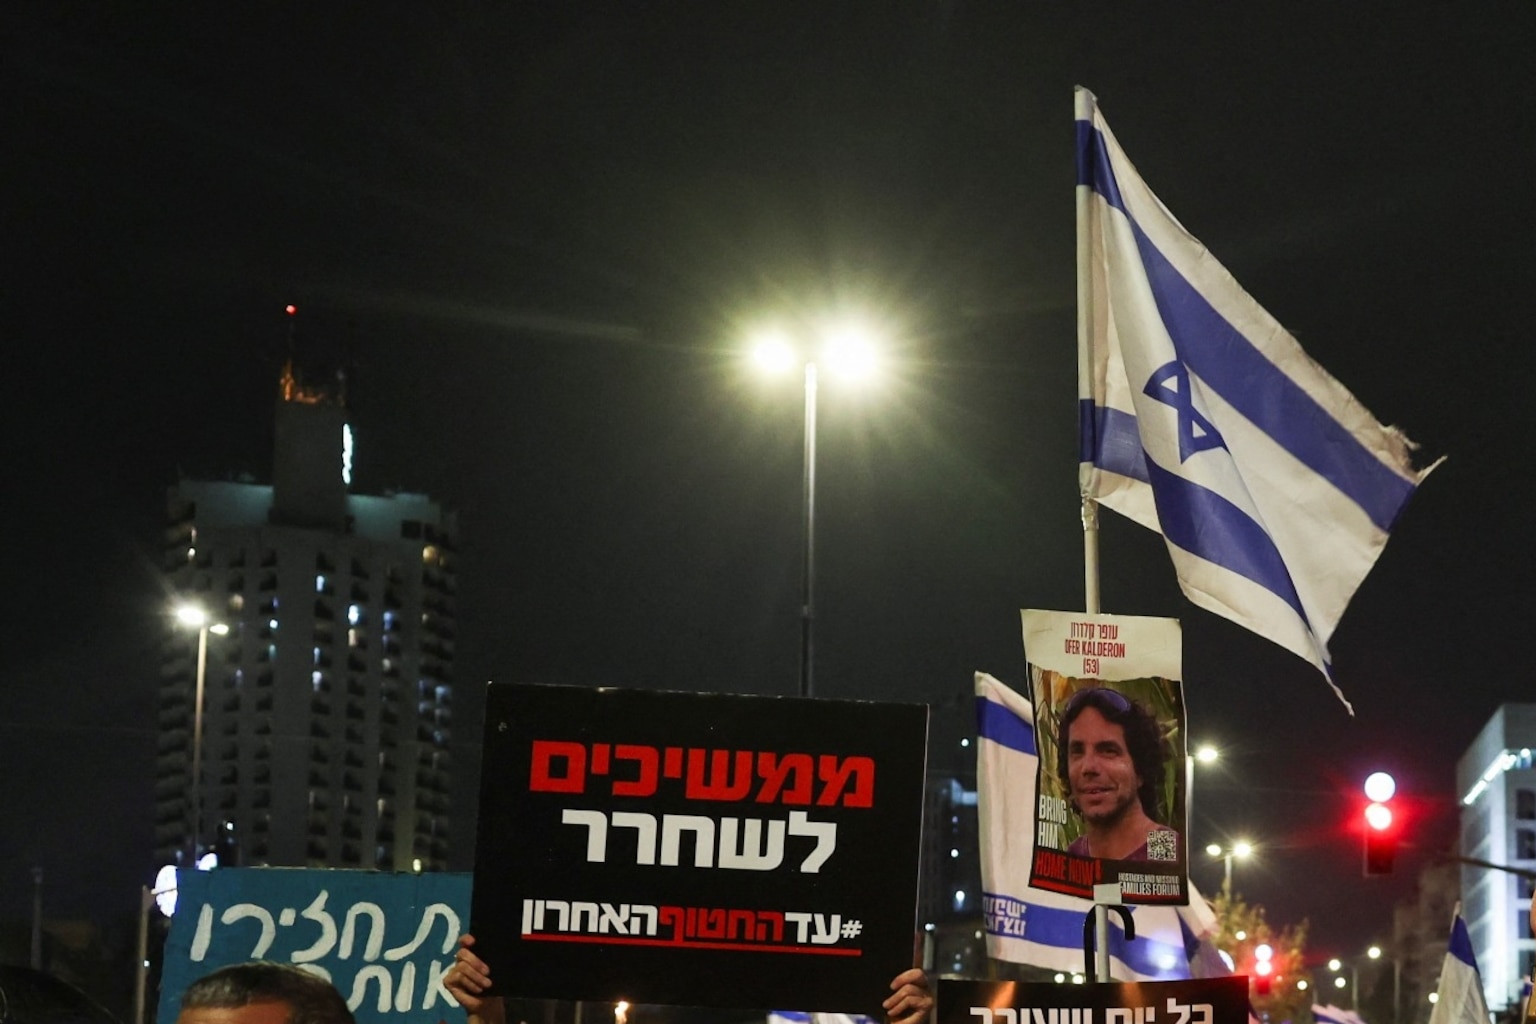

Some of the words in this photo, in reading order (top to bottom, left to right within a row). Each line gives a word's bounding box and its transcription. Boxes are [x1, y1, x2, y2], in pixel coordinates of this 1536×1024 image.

[1070, 621, 1096, 640] קלדרון
[1098, 624, 1119, 640] עופר
[1064, 638, 1081, 655] OFER
[1081, 642, 1126, 658] KALDERON
[1082, 658, 1100, 676] (53)
[529, 740, 875, 808] ממשיכים
[1038, 795, 1068, 825] BRING
[561, 809, 837, 873] לשחרר
[1037, 820, 1060, 850] HIM
[1035, 850, 1067, 881] HOME
[1119, 882, 1151, 895] FAMILIES
[1152, 883, 1181, 896] FORUM
[190, 889, 461, 963] תחזירו
[299, 960, 460, 1013] אות
